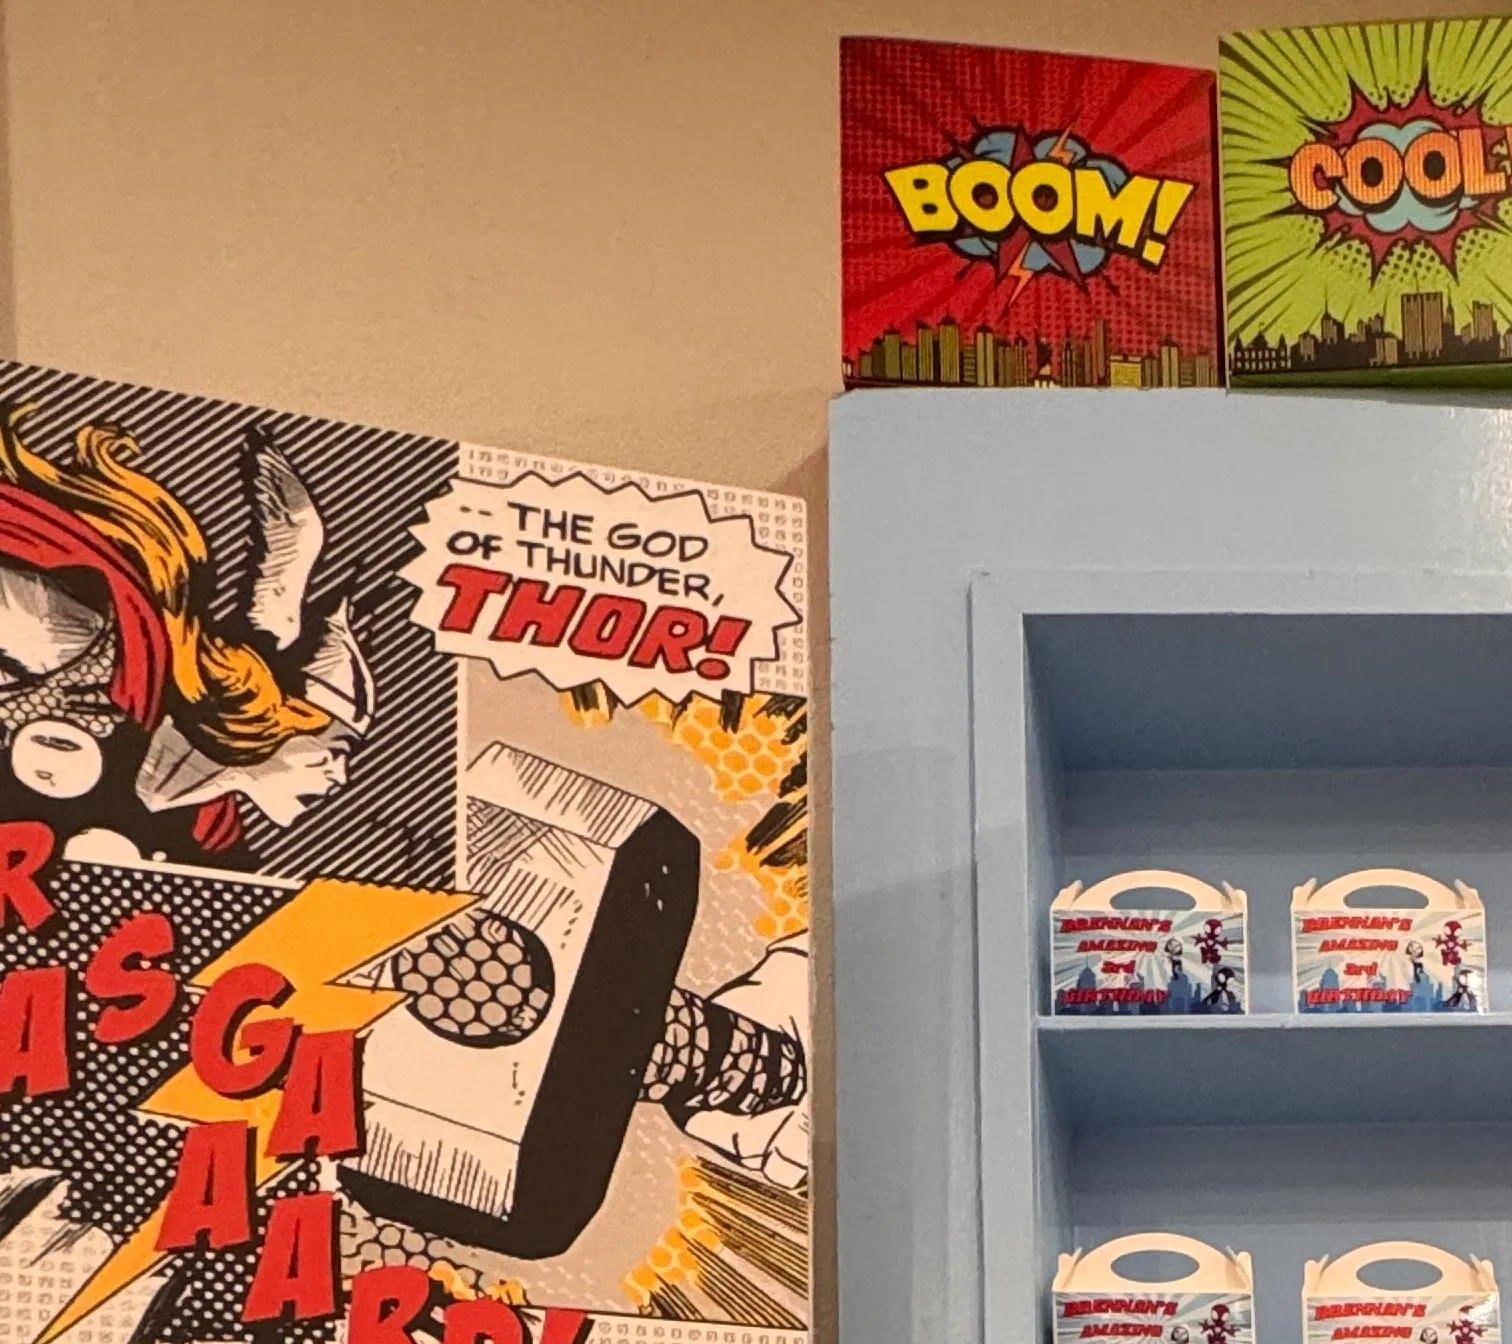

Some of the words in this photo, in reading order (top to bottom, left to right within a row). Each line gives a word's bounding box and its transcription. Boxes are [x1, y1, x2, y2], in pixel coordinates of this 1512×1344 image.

[883, 157, 1198, 272] BOOM!
[446, 530, 502, 561] OF
[516, 539, 725, 608] THUNDER,
[507, 500, 594, 545] THE
[607, 522, 709, 562] GOD
[437, 562, 752, 681] THOR!
